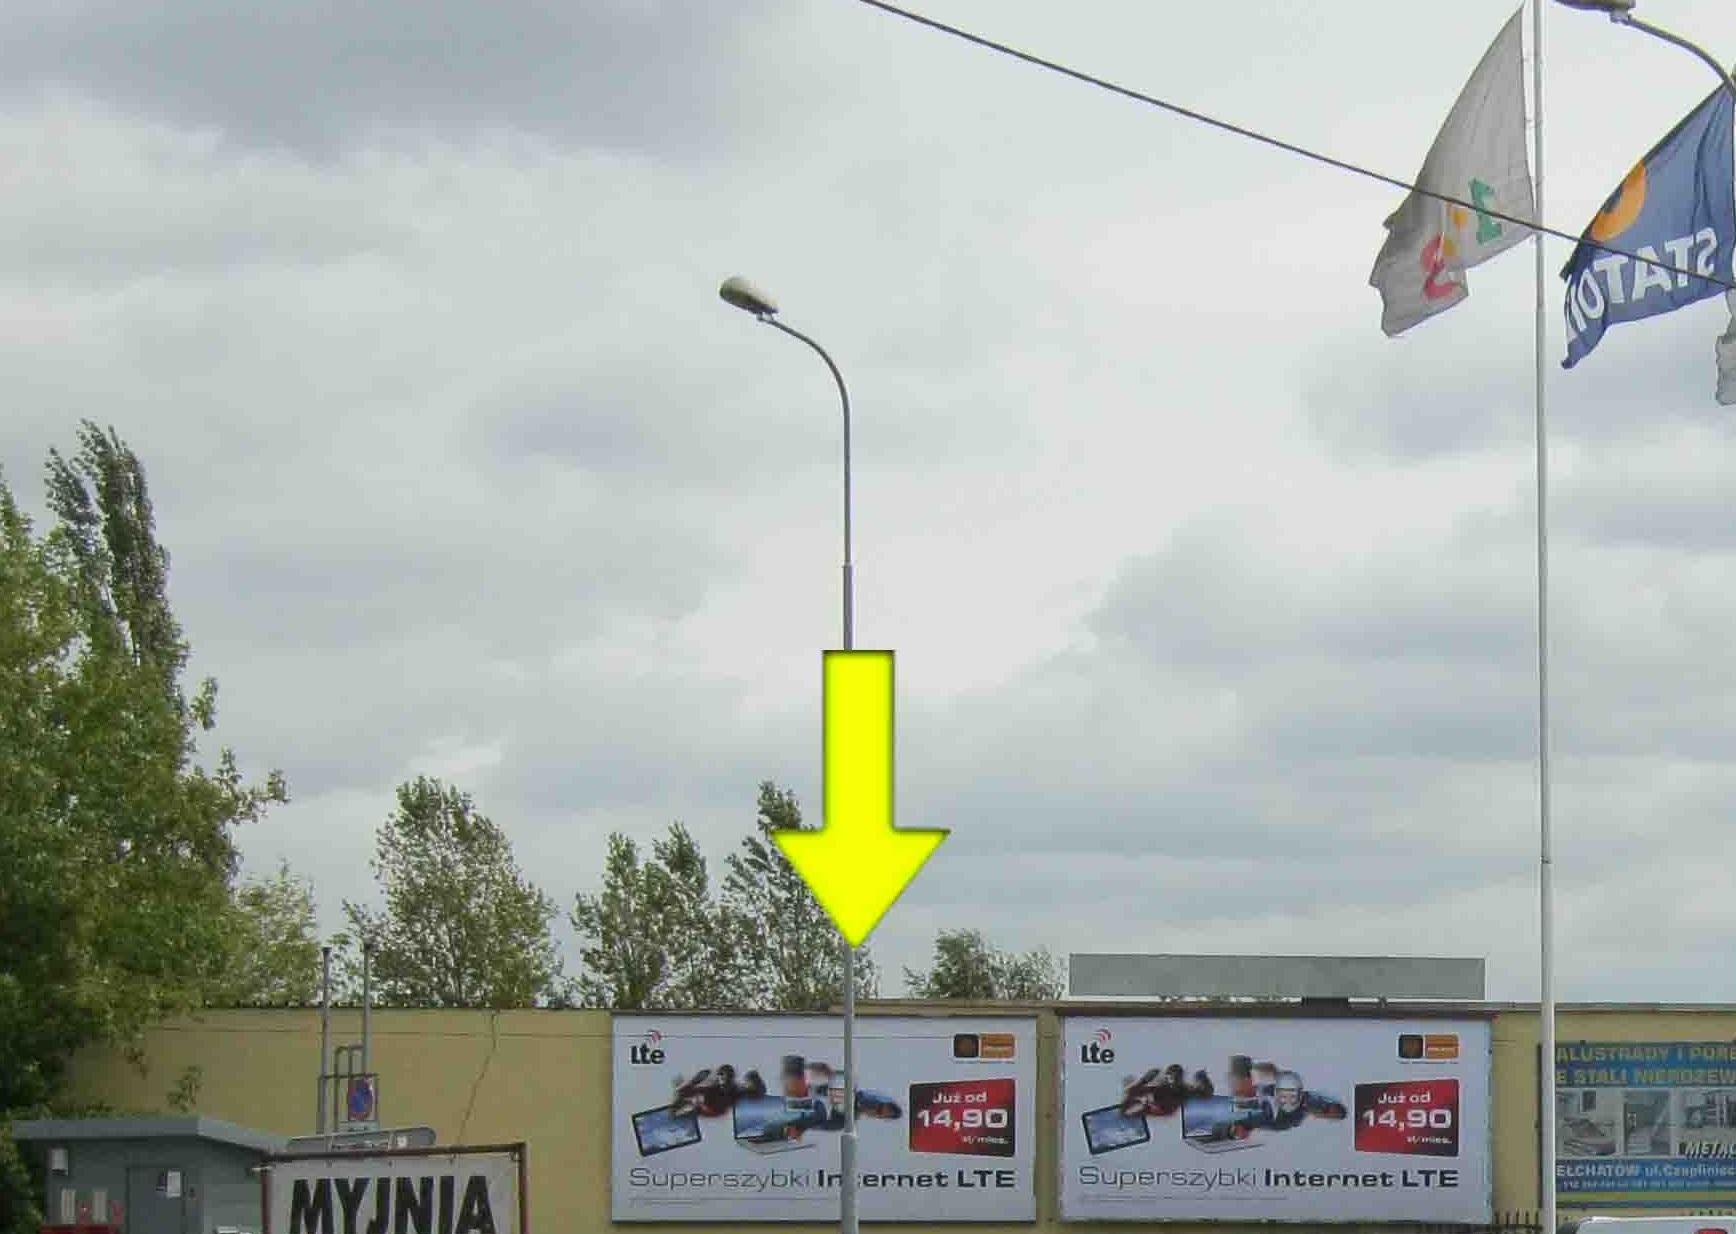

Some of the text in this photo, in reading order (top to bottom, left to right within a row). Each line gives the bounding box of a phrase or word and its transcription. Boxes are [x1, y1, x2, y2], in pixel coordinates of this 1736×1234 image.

[1556, 1046, 1669, 1062] ALUSTRADY
[965, 1091, 988, 1104] od
[1408, 1091, 1432, 1104] od
[918, 1108, 1009, 1131] 14,90
[1363, 1108, 1452, 1132] 14,90
[629, 1167, 1016, 1192] Superszybki Inernet LTE
[1079, 1166, 1459, 1192] Superszybki Internet LTE
